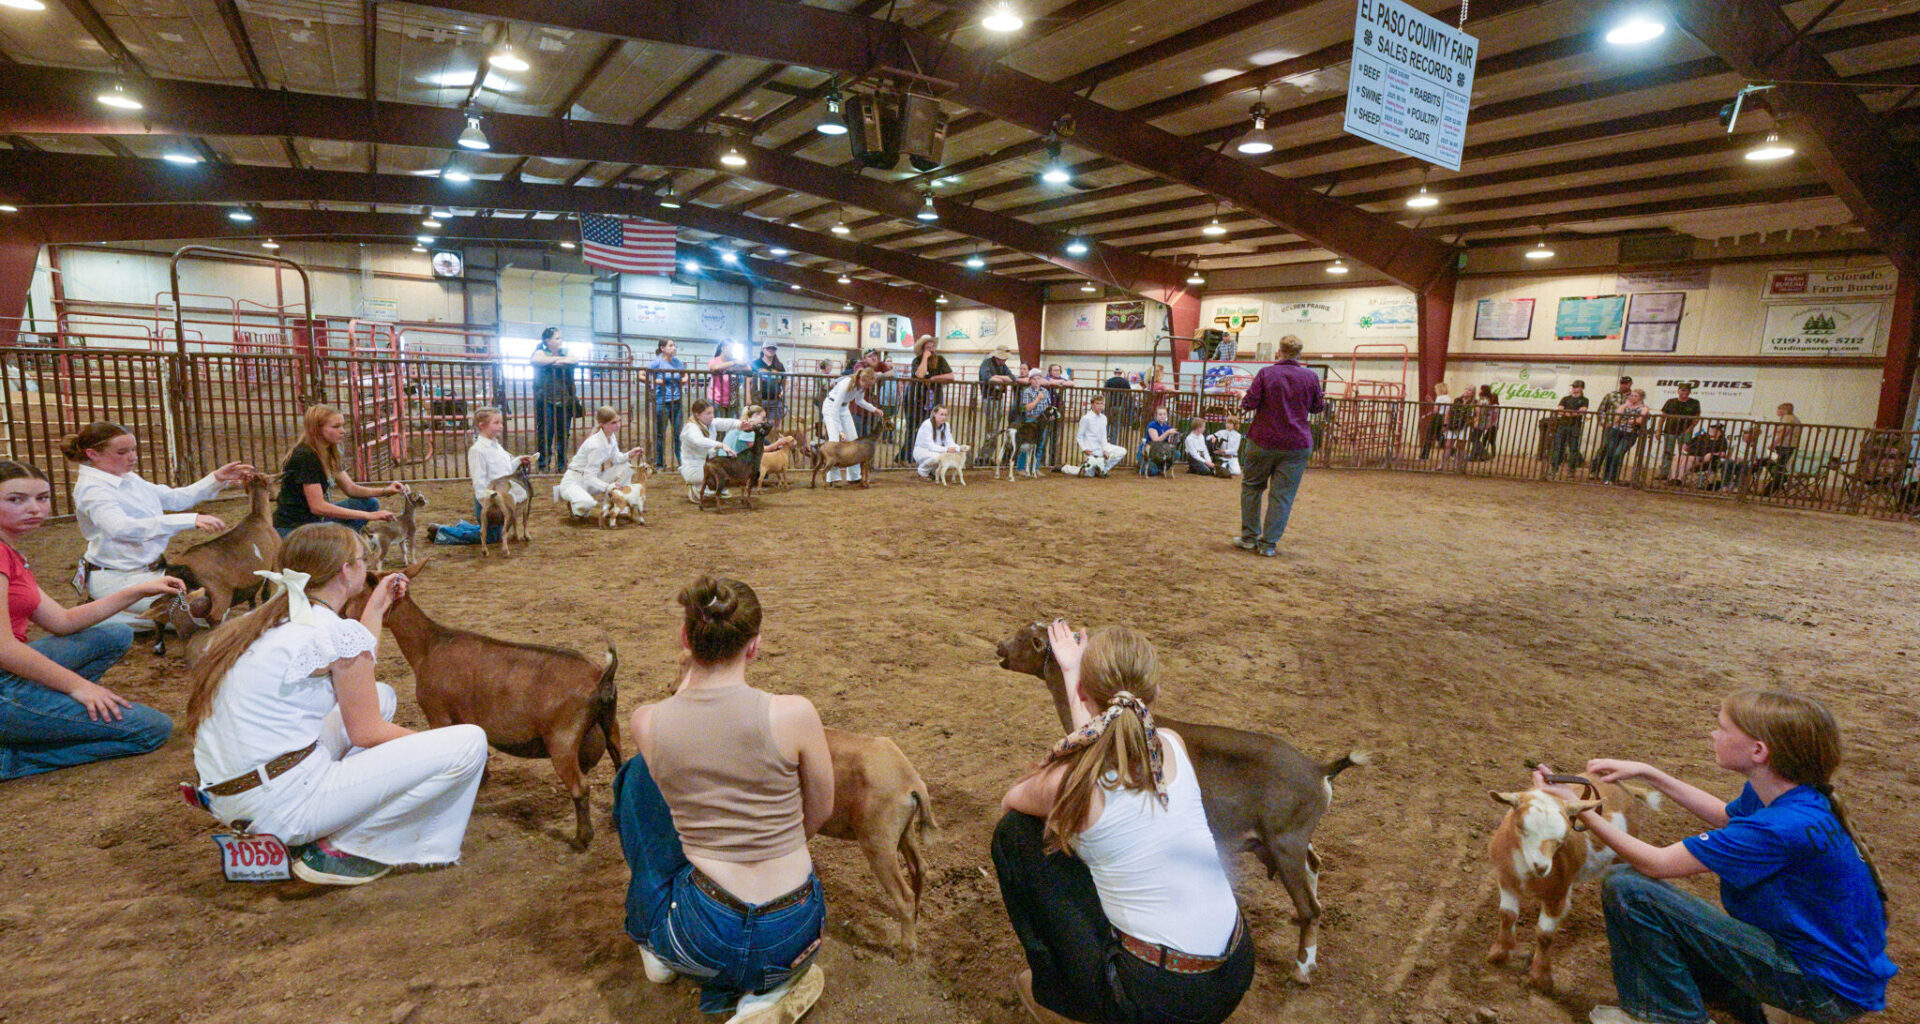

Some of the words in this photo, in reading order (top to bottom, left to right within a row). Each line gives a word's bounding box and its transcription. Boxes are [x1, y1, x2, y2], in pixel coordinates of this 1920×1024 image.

[1361, 0, 1374, 22] EL
[1377, 3, 1405, 37] PASO
[1408, 19, 1450, 57] COUNTY
[1450, 39, 1474, 68] FAIR
[1377, 36, 1408, 63] SALES
[1409, 51, 1453, 83] RECORDS
[1363, 64, 1381, 81] BEEF
[1360, 86, 1382, 105] SWINE
[1414, 87, 1441, 107] RABBITS
[1358, 107, 1380, 126] SHEEP
[1411, 107, 1439, 127] POULTRY
[1408, 128, 1430, 145] GOATS
[1826, 270, 1882, 282] Colorado
[1812, 284, 1844, 293] Farm
[1847, 282, 1893, 292] Bureau
[1306, 303, 1331, 312] PRAIRIE
[1490, 382, 1506, 395] Ed
[1505, 382, 1557, 400] Glaser
[1702, 380, 1753, 389] TIRES
[226, 841, 284, 867] 1059
